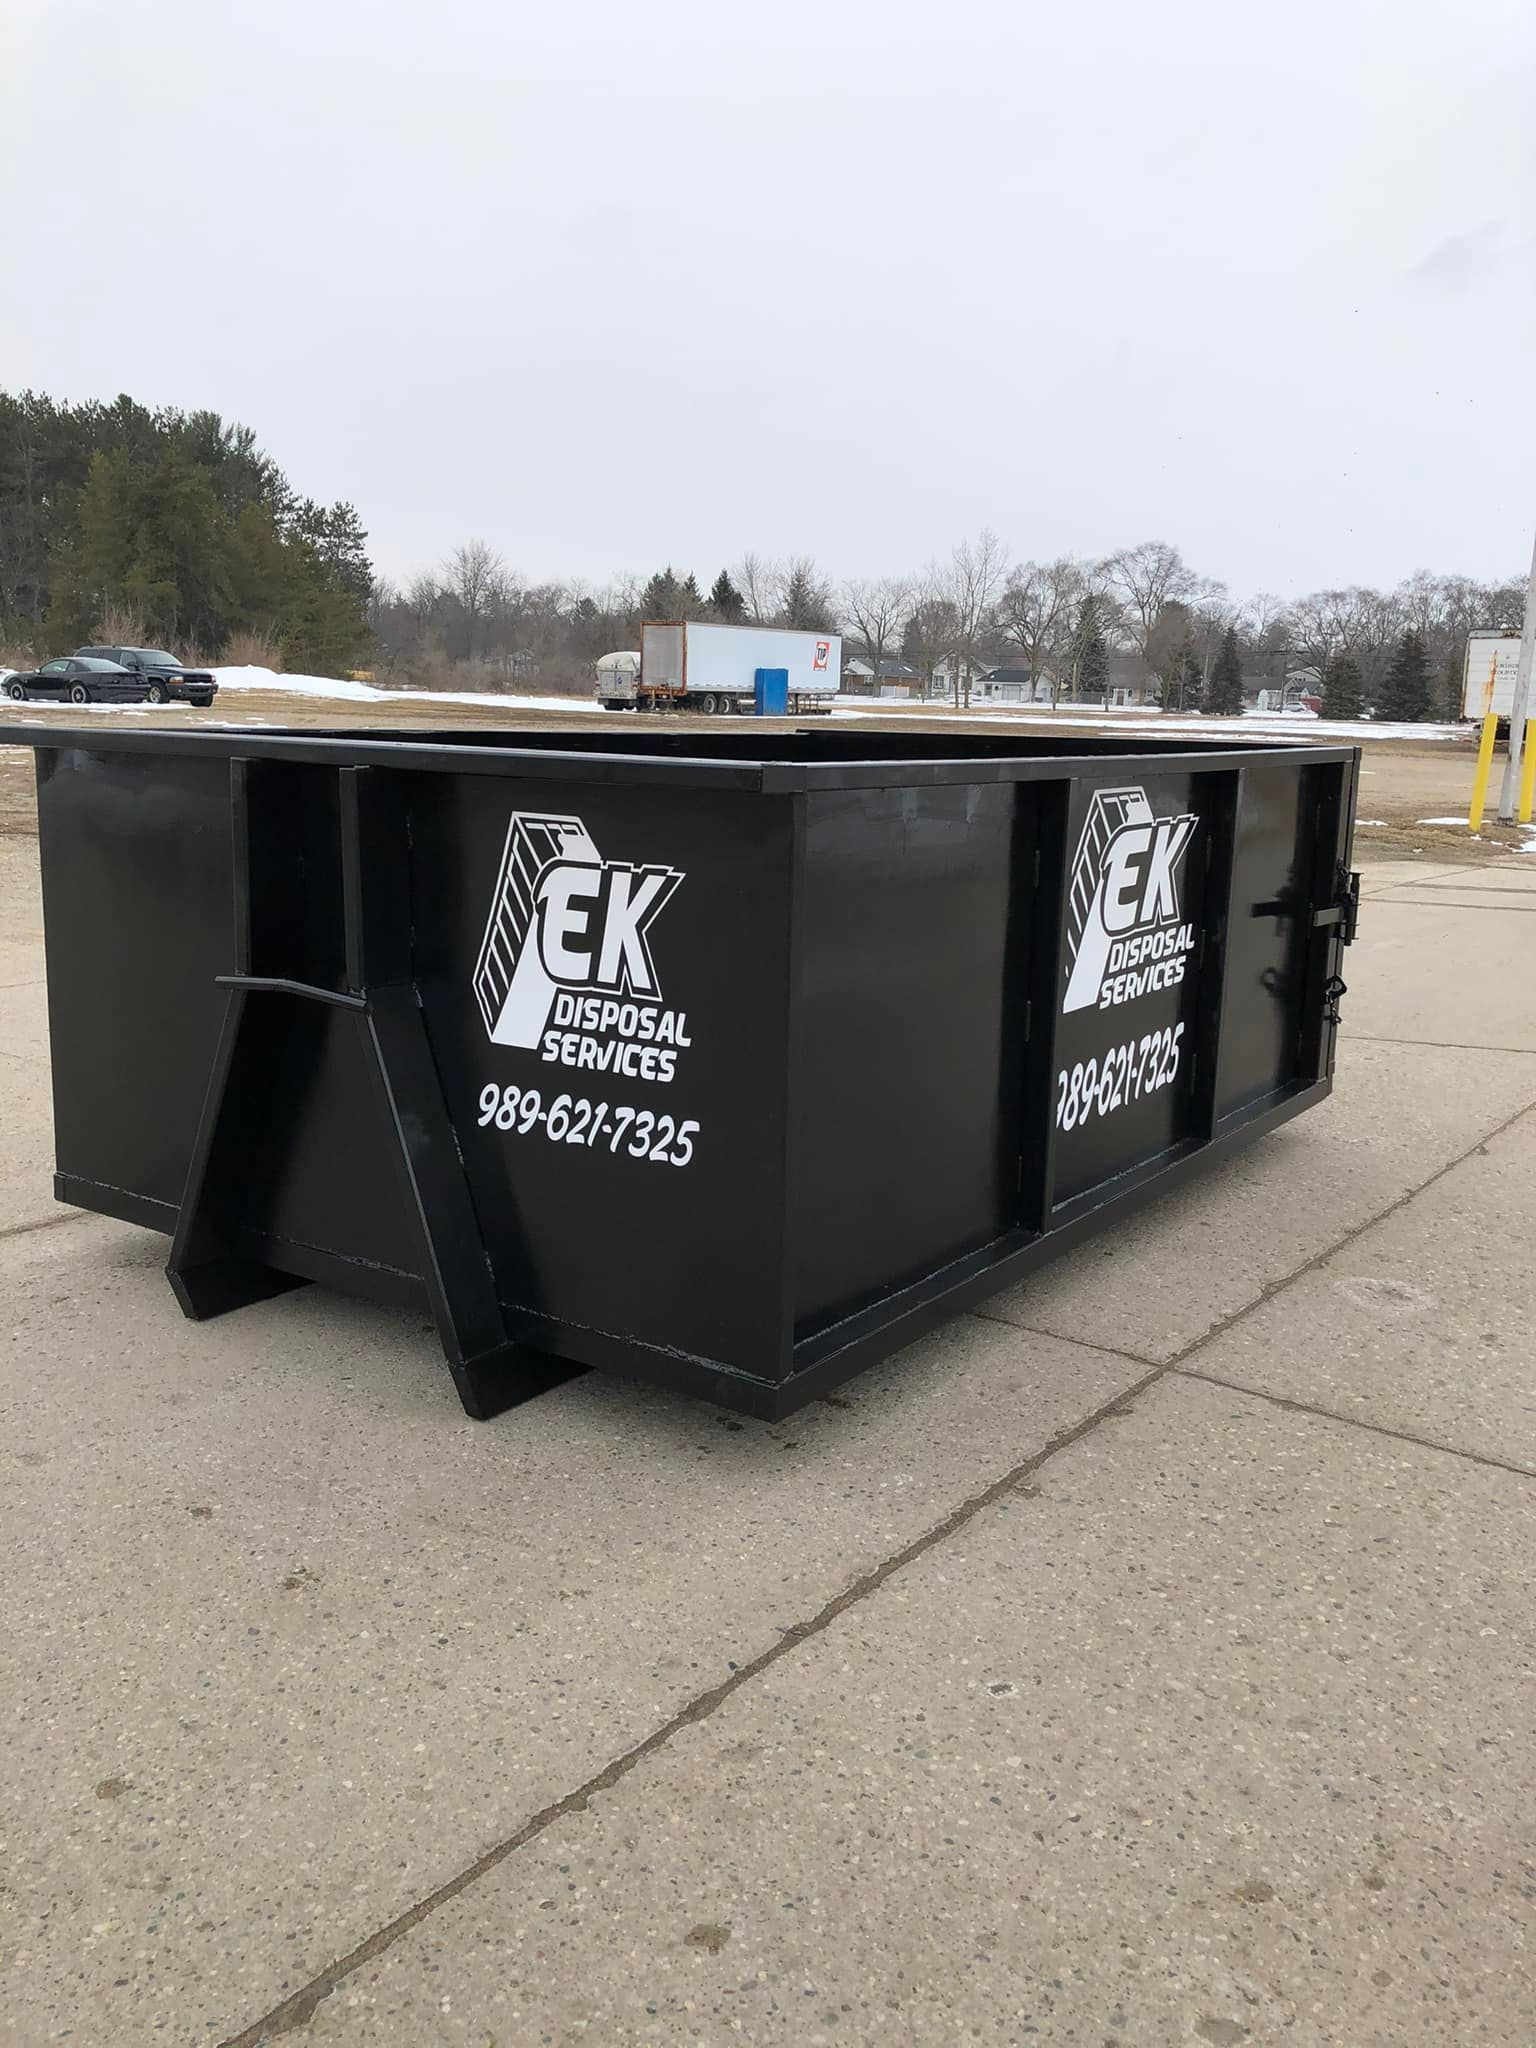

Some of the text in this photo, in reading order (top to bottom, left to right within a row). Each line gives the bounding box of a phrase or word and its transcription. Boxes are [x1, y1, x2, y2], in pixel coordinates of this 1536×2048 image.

[1103, 821, 1191, 933] EK
[537, 866, 668, 991] EK
[1108, 923, 1195, 974] DISPOSAL
[1099, 955, 1187, 1011] SERVICES
[553, 994, 692, 1046] DISPOSAL
[541, 1031, 678, 1083] SERVICES
[477, 1083, 700, 1167] 989-621-7325
